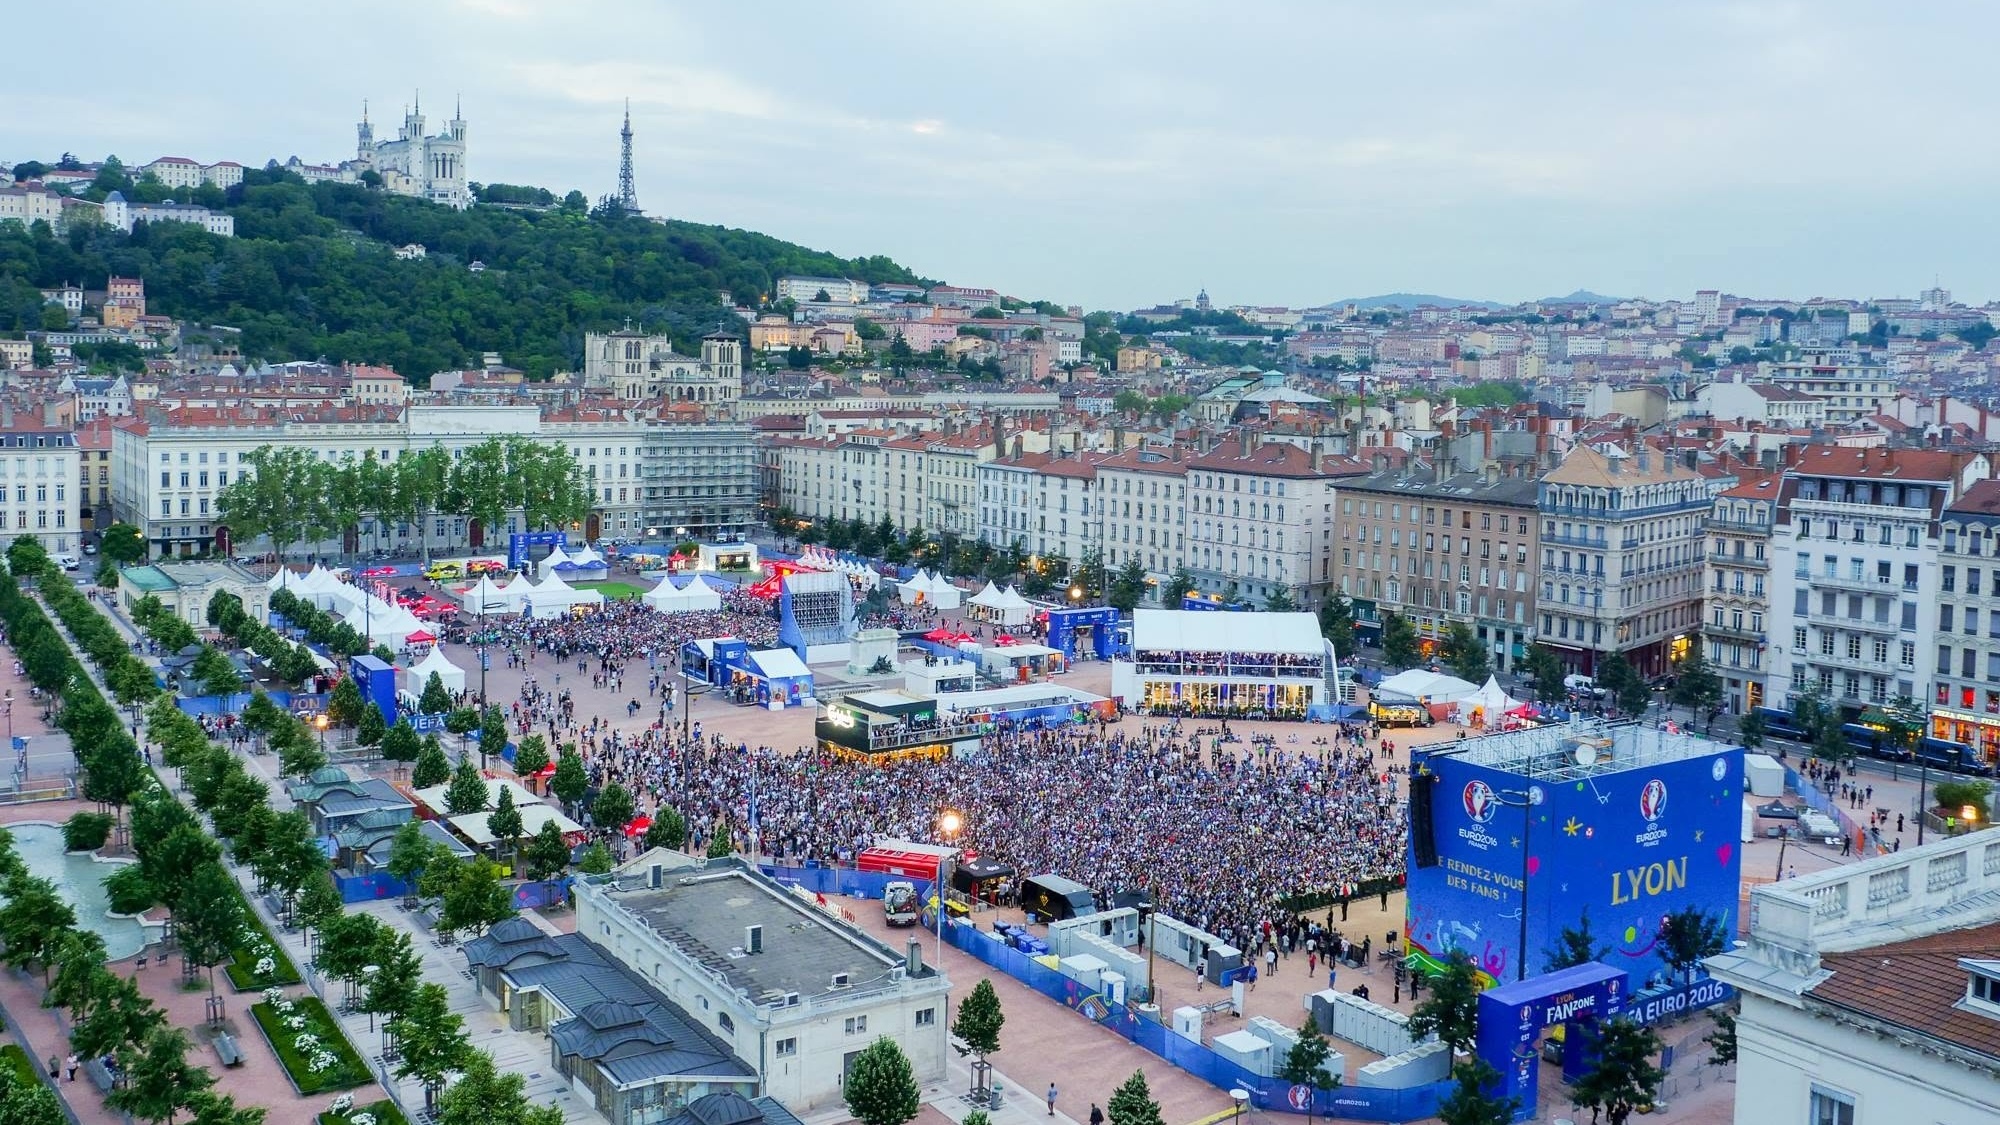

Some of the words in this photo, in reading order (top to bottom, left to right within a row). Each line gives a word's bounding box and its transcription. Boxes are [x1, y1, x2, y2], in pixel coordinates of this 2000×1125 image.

[408, 717, 446, 730] UEFA
[1458, 828, 1498, 847] EURO2016
[1467, 840, 1488, 851] FRANCE
[1636, 829, 1667, 843] EURO2016
[1448, 858, 1524, 891] RENDEZ-VOUS
[1611, 856, 1689, 906] LYON
[1447, 874, 1468, 890] DES
[1471, 882, 1500, 901] FANS
[1688, 981, 1724, 1007] 2016
